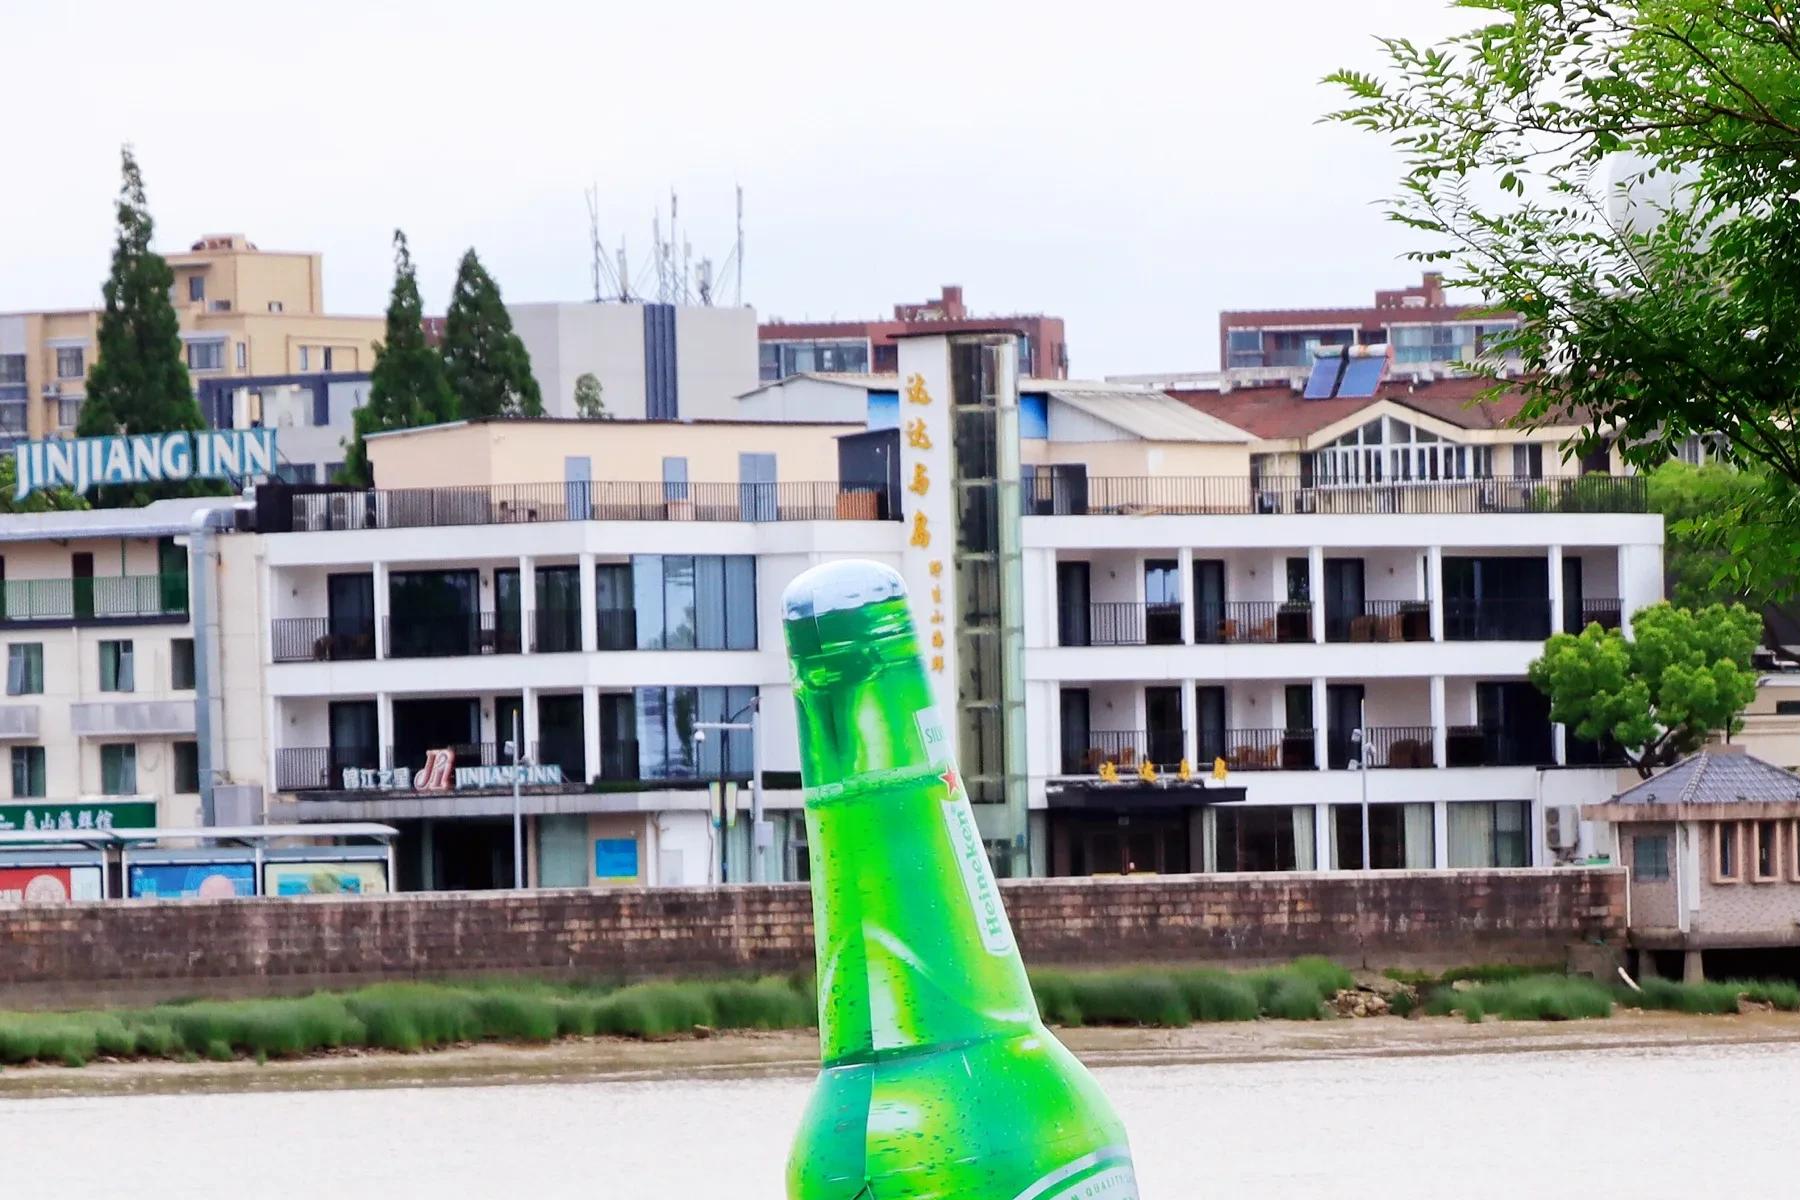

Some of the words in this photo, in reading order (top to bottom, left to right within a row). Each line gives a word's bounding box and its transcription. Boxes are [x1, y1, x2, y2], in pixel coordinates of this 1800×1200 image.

[14, 432, 190, 502] JINJIANG
[197, 429, 272, 478] INN
[455, 766, 527, 790] JINJIANG
[527, 764, 562, 784] INN
